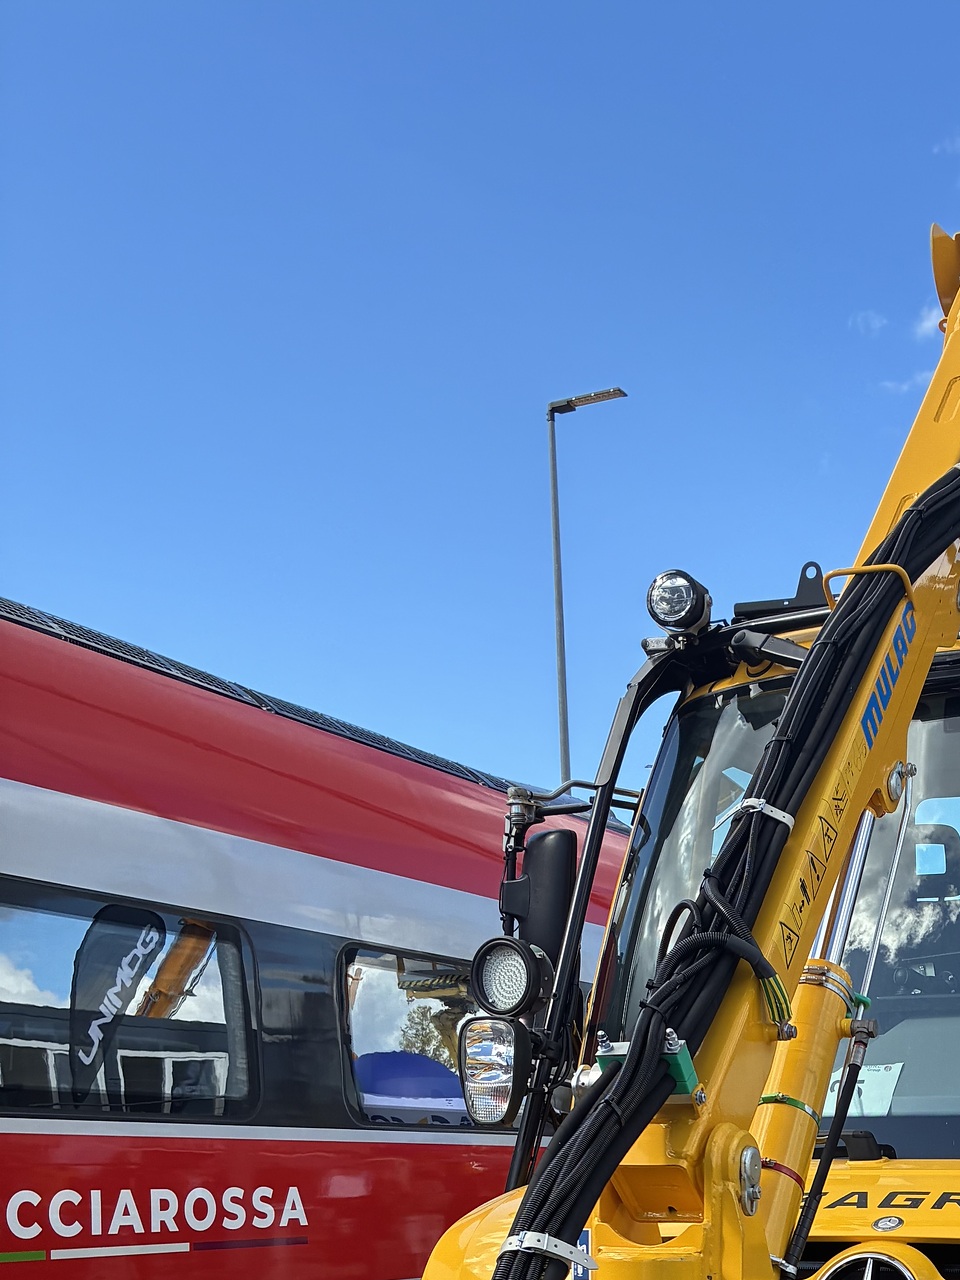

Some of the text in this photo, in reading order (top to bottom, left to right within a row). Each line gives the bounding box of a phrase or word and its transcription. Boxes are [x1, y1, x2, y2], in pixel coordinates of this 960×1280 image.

[860, 600, 917, 750] MULAG
[78, 924, 159, 1066] UNIMOG
[6, 1186, 309, 1240] CCIAROSSA
